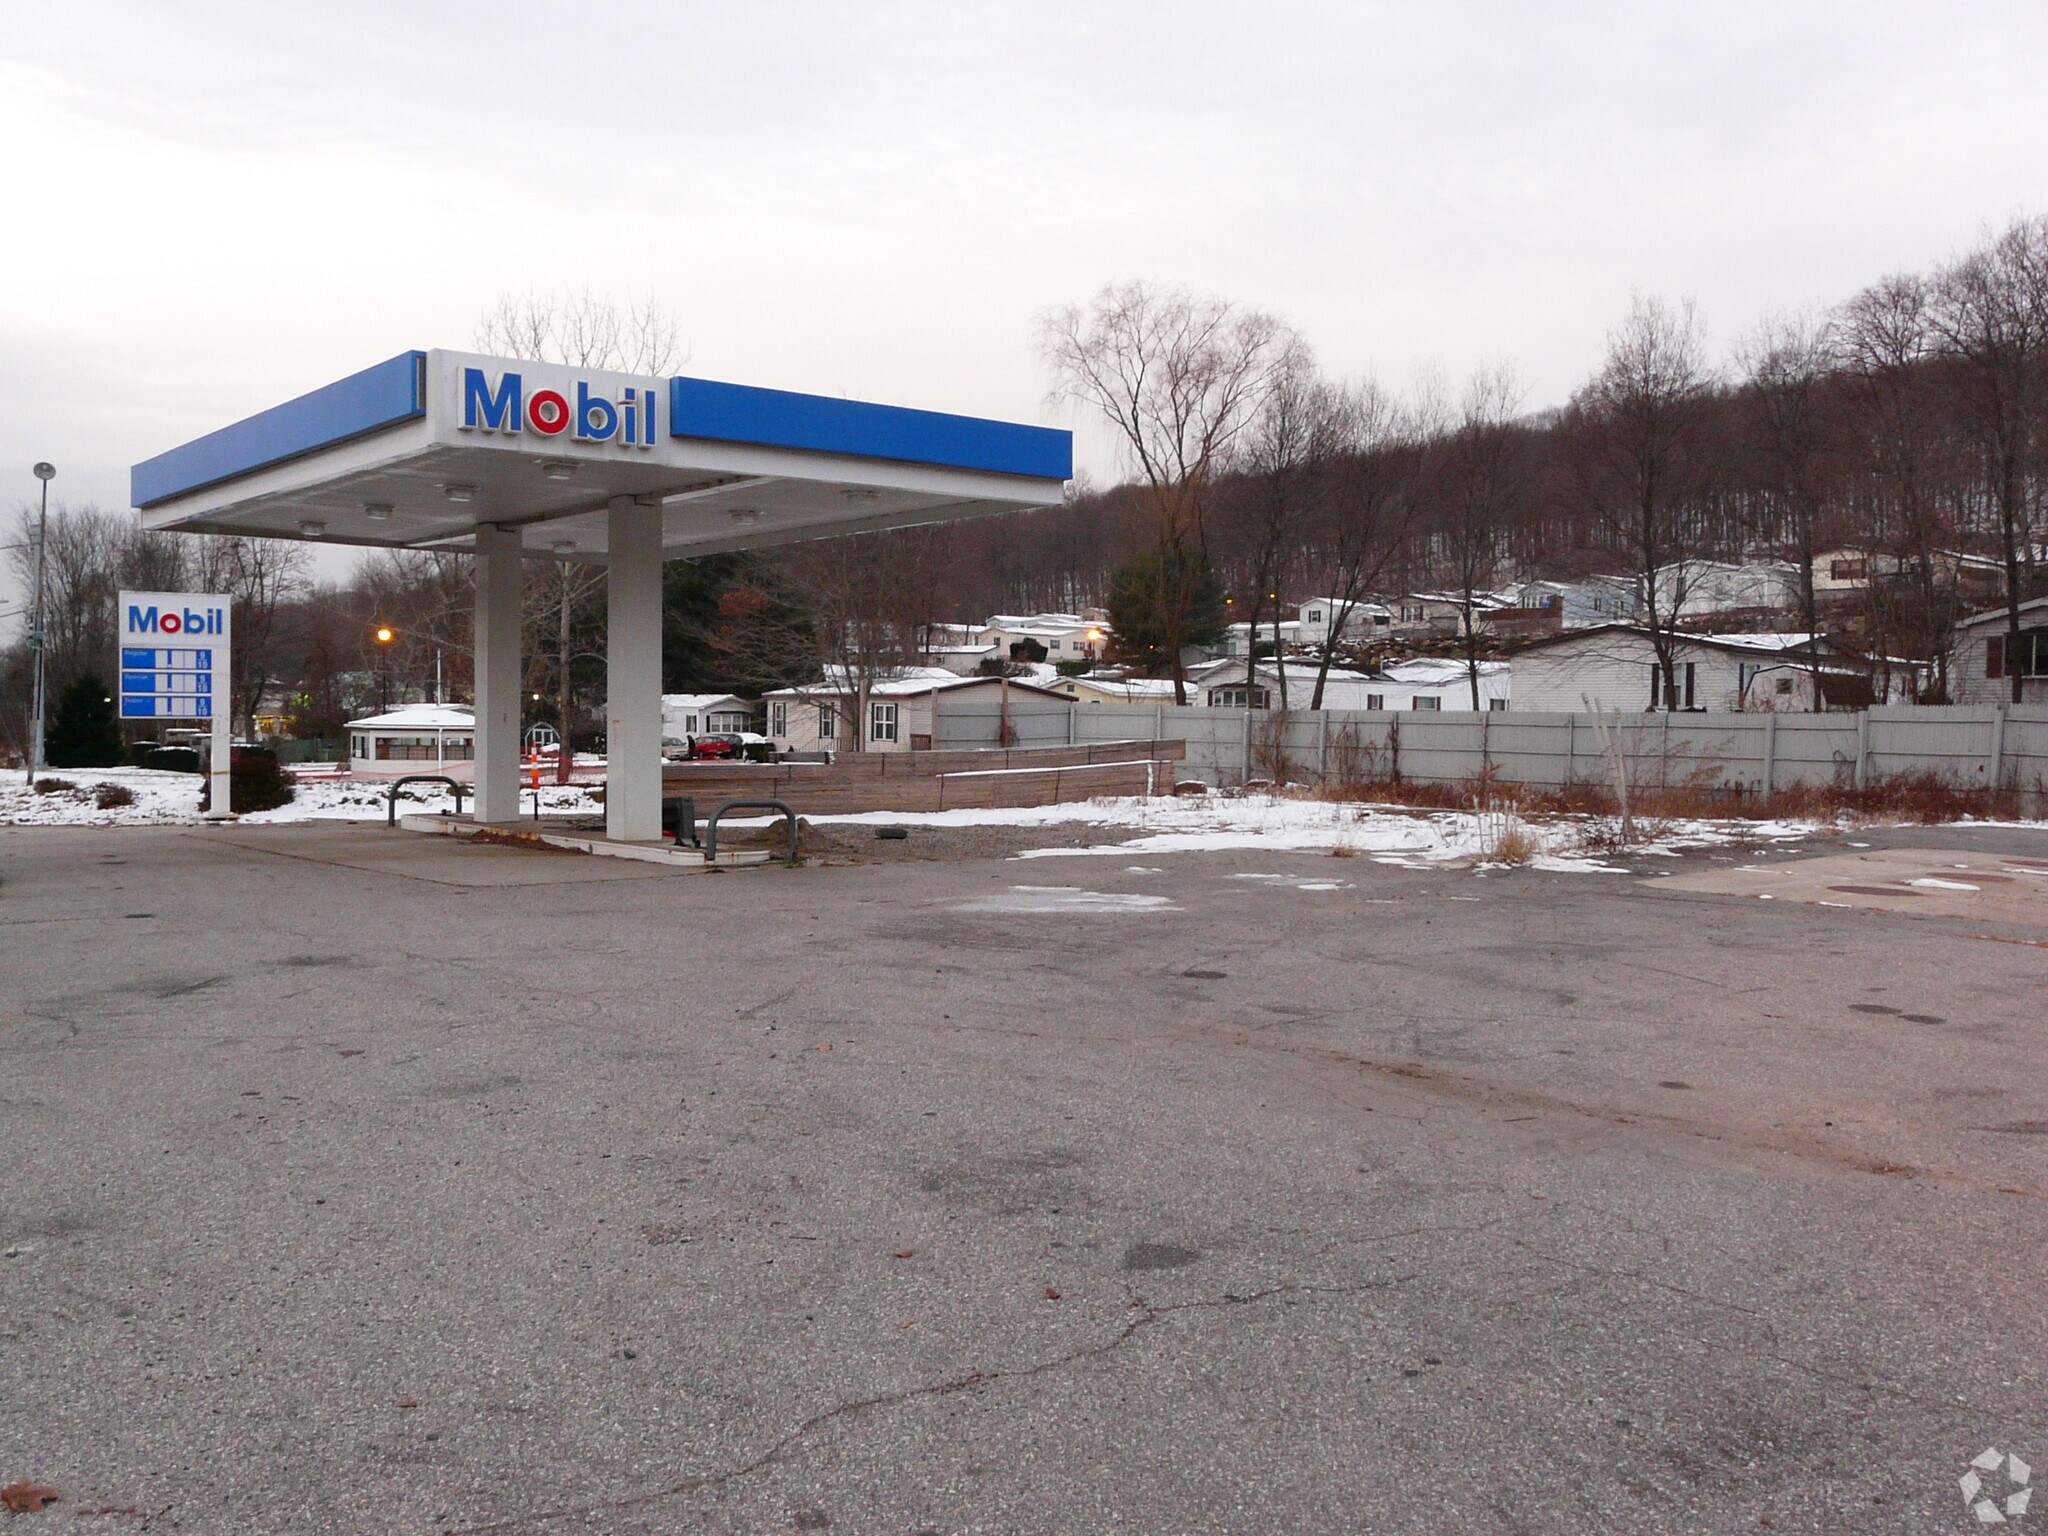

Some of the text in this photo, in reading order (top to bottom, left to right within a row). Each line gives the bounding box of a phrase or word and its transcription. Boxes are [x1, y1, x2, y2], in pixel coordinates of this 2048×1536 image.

[463, 367, 656, 446] Mobil
[128, 605, 223, 635] Mobil
[198, 661, 208, 669] 10
[198, 684, 208, 693] 10
[198, 708, 208, 716] 10
